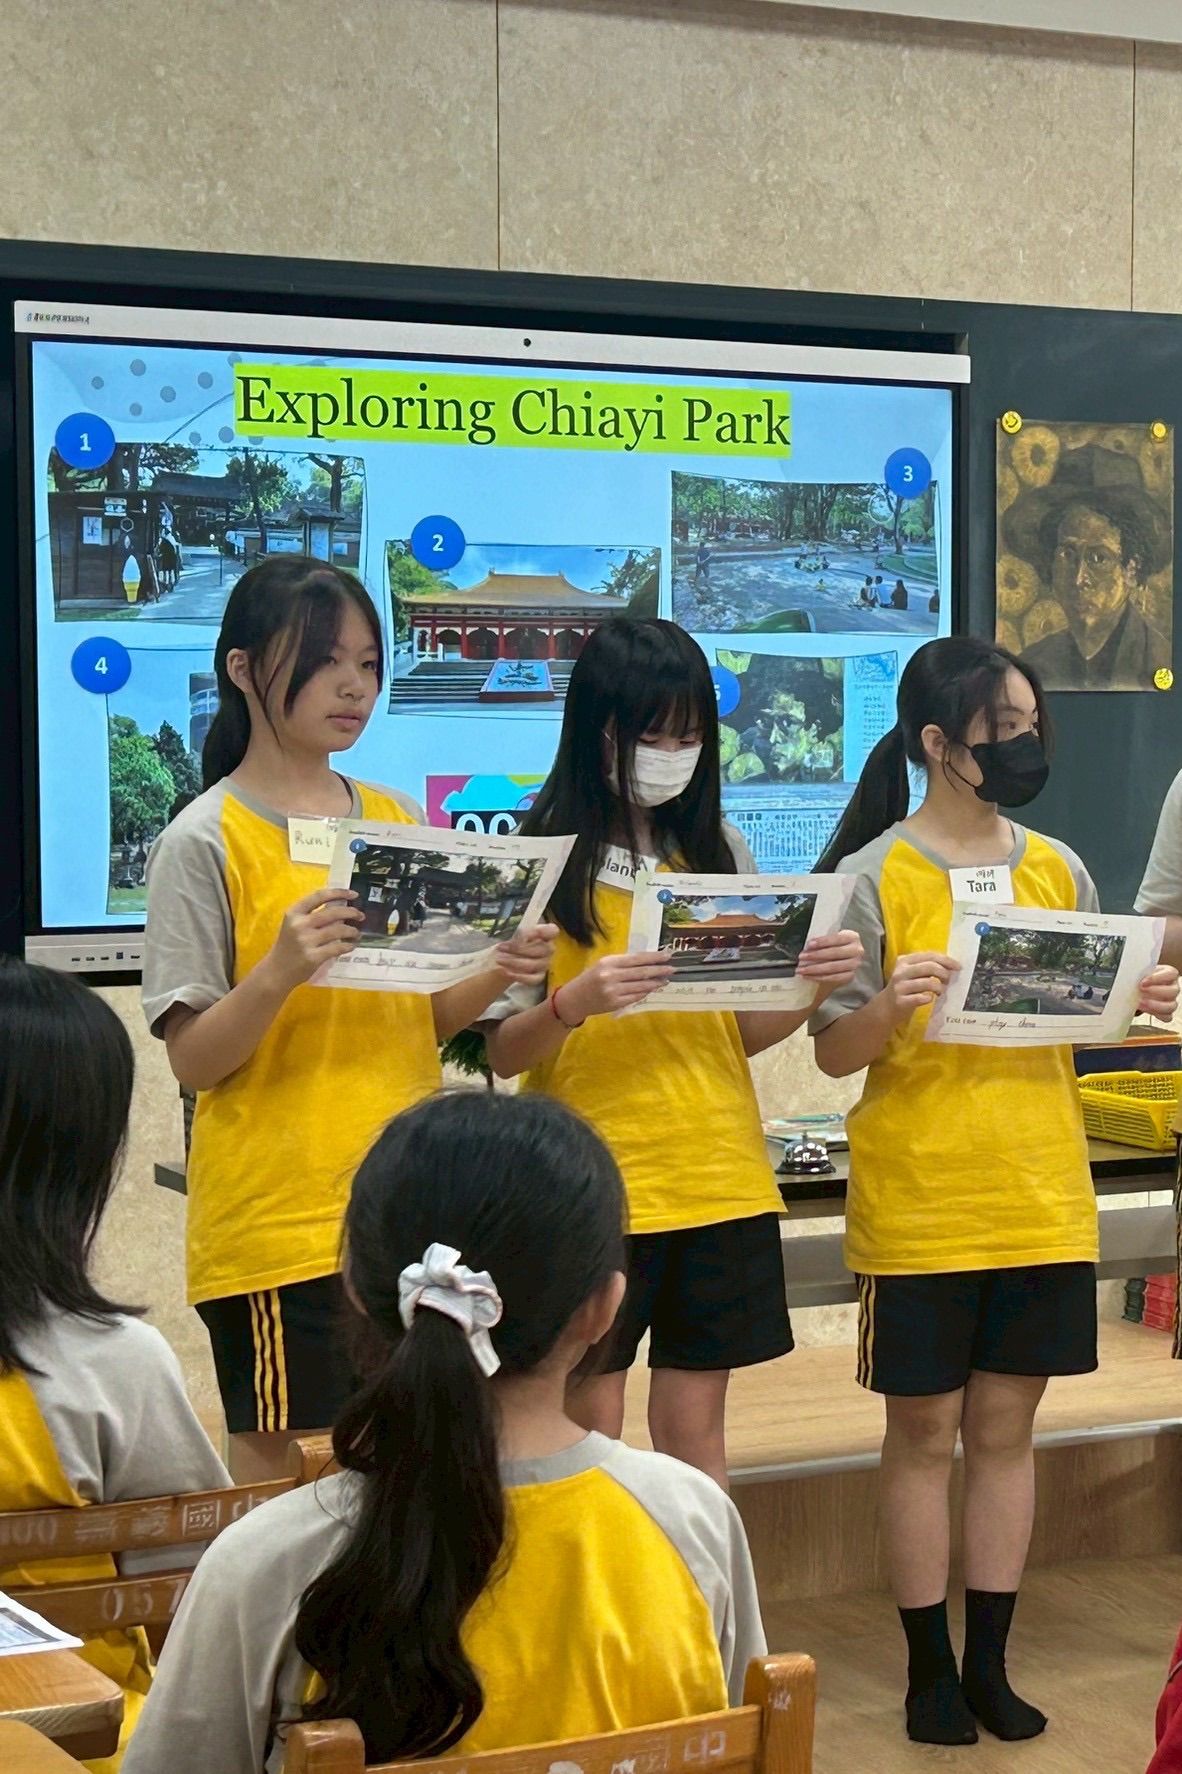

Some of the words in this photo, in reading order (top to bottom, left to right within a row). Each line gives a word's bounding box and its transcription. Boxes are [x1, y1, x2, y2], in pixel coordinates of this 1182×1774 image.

[236, 376, 496, 445] Exploring
[511, 389, 666, 451] Chiayi
[683, 398, 791, 446] Park
[79, 433, 91, 451] 1
[903, 465, 913, 482] 3
[432, 535, 444, 552] 2
[95, 657, 108, 674] 4
[966, 880, 996, 893] Tara
